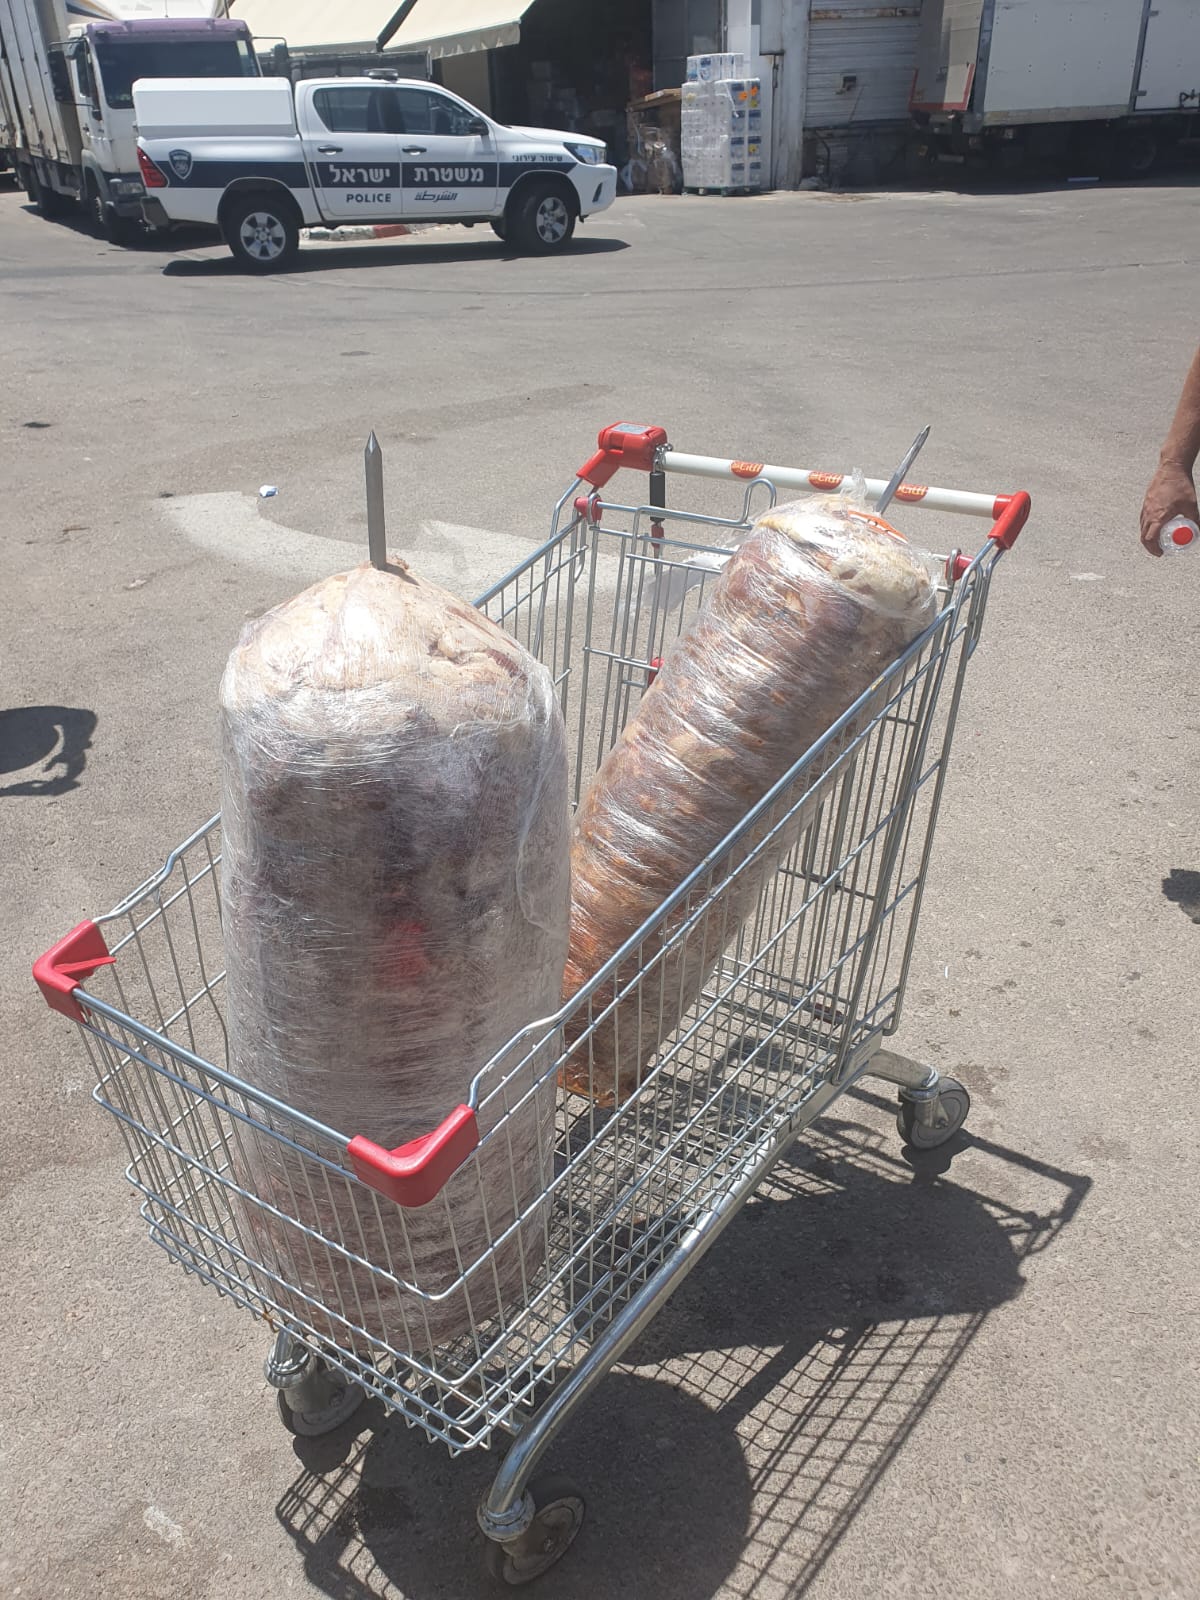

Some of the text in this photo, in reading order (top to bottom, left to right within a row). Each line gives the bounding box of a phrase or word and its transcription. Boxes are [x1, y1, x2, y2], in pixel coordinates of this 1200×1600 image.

[329, 164, 484, 183] משטרת ישראל
[346, 193, 391, 203] POLICE
[414, 190, 458, 203] الشرطة
